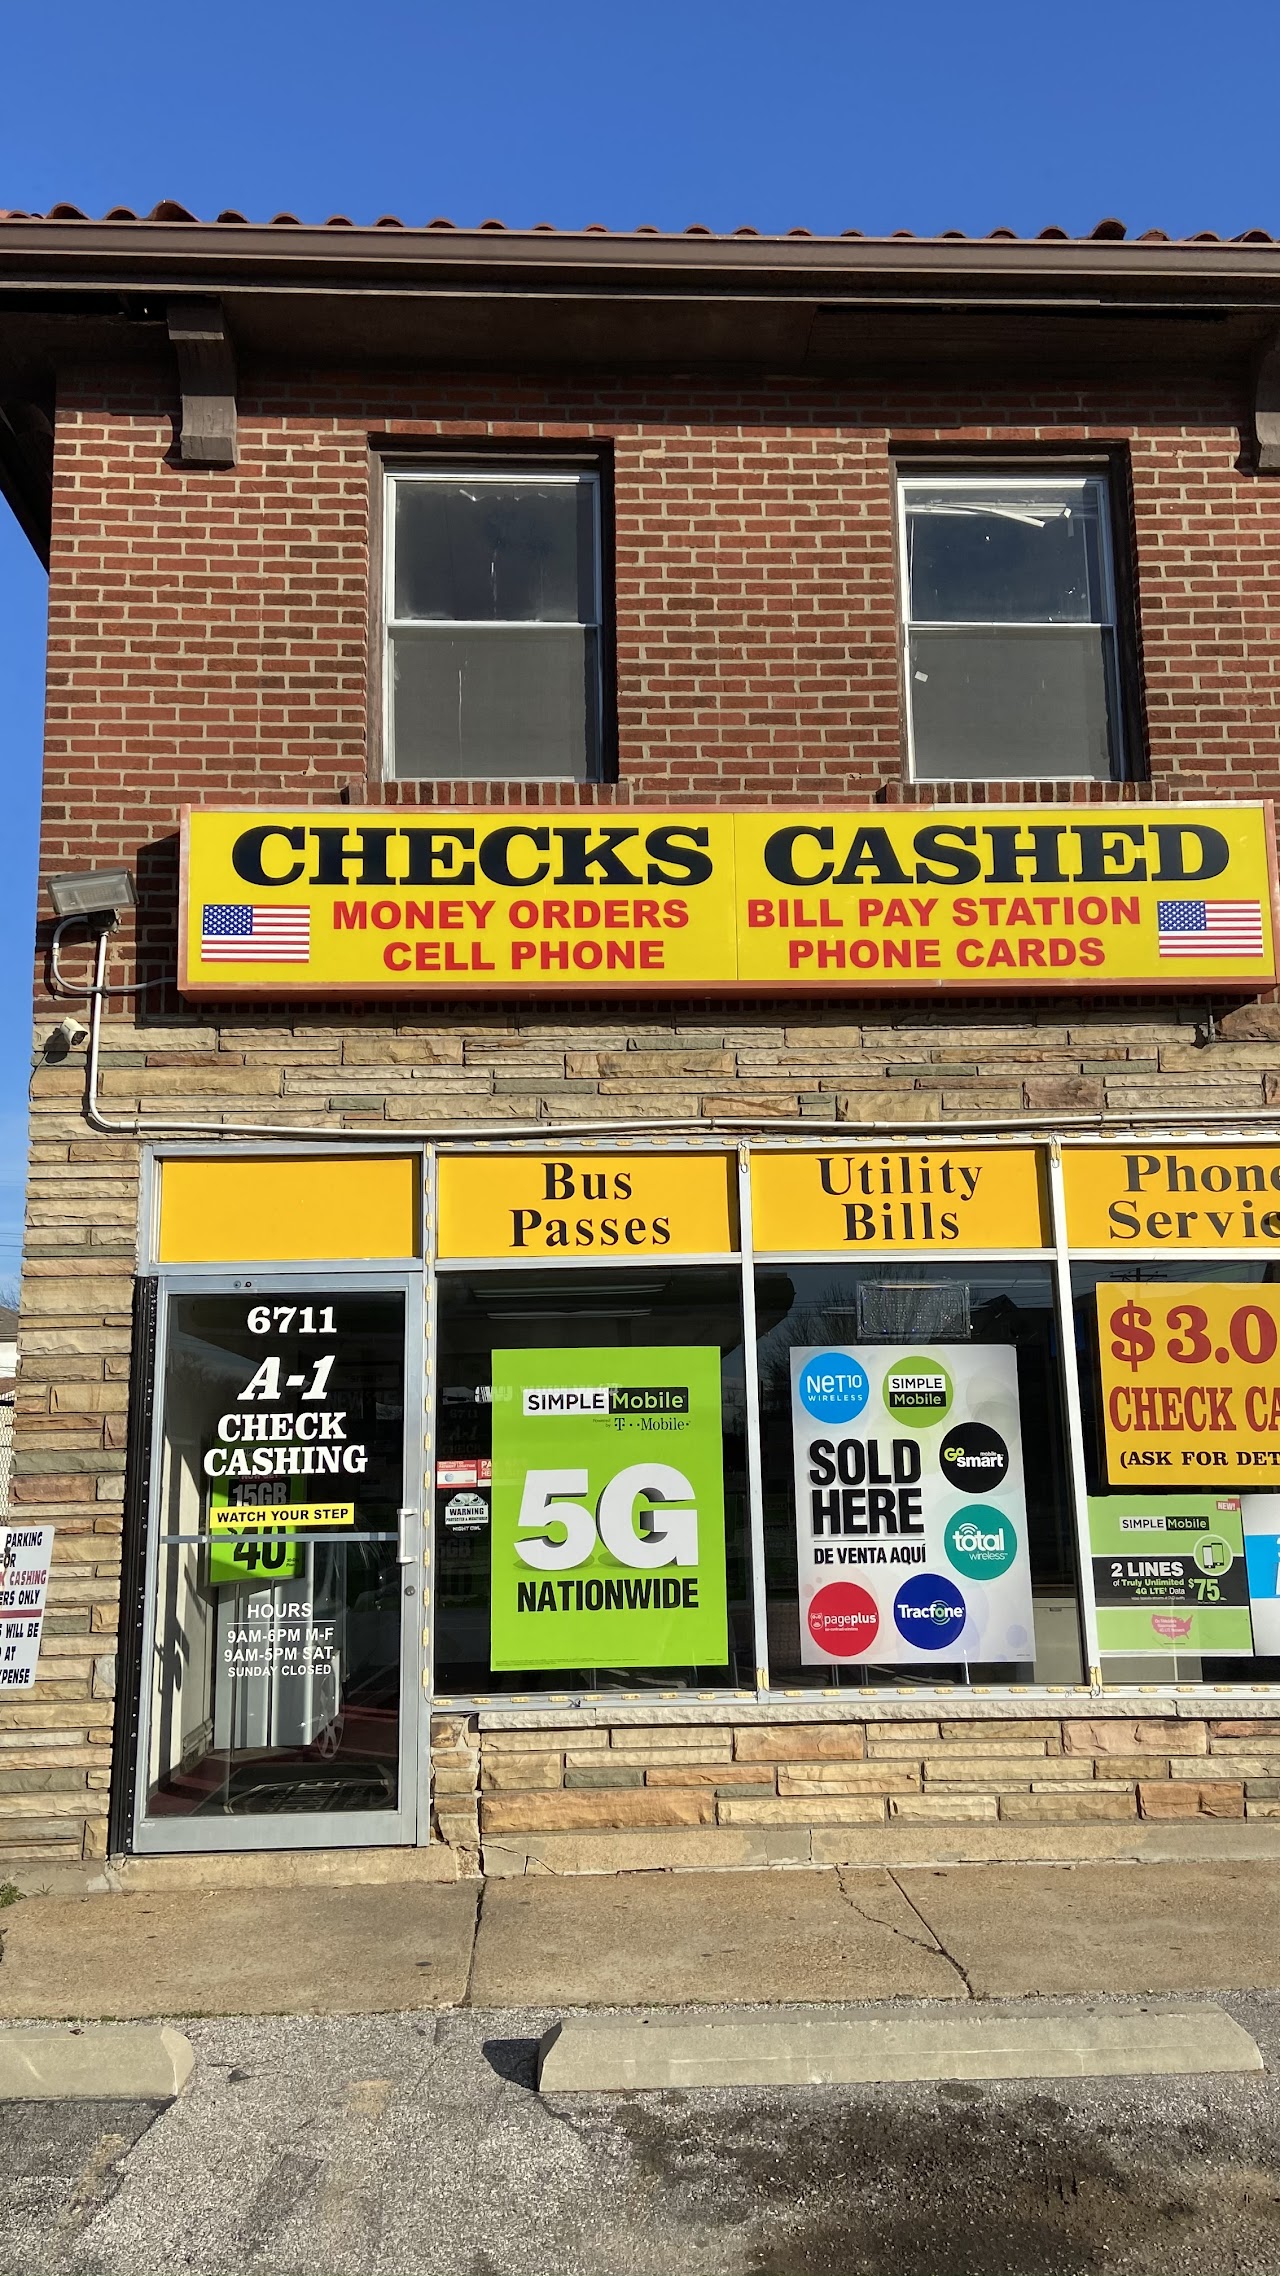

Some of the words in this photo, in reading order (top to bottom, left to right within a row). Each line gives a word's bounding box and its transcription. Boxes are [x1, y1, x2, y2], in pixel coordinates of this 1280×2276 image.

[231, 824, 714, 887] CHECKS
[763, 823, 1230, 886] CASHED
[333, 899, 496, 930] MONEY
[509, 899, 690, 929] ORDERS
[747, 898, 844, 928] BILL
[859, 898, 936, 927] PAY
[952, 896, 1141, 927] STATION
[383, 941, 495, 971] CELL
[511, 940, 665, 970] PHONE
[789, 938, 941, 969] PHONE
[956, 937, 1106, 967] CARDS
[541, 1162, 633, 1201] Bus
[816, 1155, 984, 1202] Utility
[508, 1208, 672, 1248] Passes
[842, 1202, 961, 1242] Bills
[246, 1305, 338, 1335] 6711
[236, 1354, 336, 1401] A-1
[892, 1378, 943, 1389] SIMPLE
[528, 1392, 606, 1411] SIMPLE
[612, 1391, 685, 1410] Mobile
[808, 1394, 863, 1402] WIRELESS
[894, 1393, 942, 1406] Mobile
[1109, 1385, 1237, 1433] CHECK
[217, 1411, 347, 1443] CHECK
[203, 1444, 368, 1478] CASHING
[808, 1438, 923, 1487] SOLD
[1120, 1450, 1173, 1469] (ASK
[1181, 1450, 1229, 1467] FOR
[449, 1507, 484, 1516] WARNING
[811, 1487, 925, 1536] HERE
[1217, 1501, 1236, 1511] NEW!
[217, 1511, 266, 1523] WATCH
[271, 1510, 309, 1522] YOUR
[314, 1508, 349, 1520] STEP
[513, 1462, 699, 1571] 5G
[1122, 1518, 1164, 1529] SIMPLE
[1167, 1517, 1207, 1529] Mobile
[5, 1531, 43, 1548] PARKING
[952, 1527, 1005, 1553] total
[814, 1547, 834, 1565] DE
[838, 1546, 887, 1564] VENTA
[890, 1543, 927, 1565] AQUÍ
[969, 1552, 1006, 1561] wireless
[9, 1569, 47, 1586] CASHING
[1110, 1562, 1124, 1578] 2
[1127, 1561, 1184, 1577] LINES
[1112, 1579, 1120, 1587] of
[1120, 1578, 1143, 1588] Truly
[1144, 1578, 1185, 1587] Unlimited
[1135, 1587, 1148, 1595] 4G
[1168, 1587, 1186, 1595] Data
[18, 1589, 40, 1605] ONLY
[516, 1577, 700, 1613] NATIONWIDE
[247, 1602, 312, 1619] HOURS
[824, 1611, 877, 1627] pageplus
[897, 1604, 963, 1620] Tracfone
[5, 1623, 24, 1638] WILL
[27, 1622, 39, 1637] BE
[227, 1628, 301, 1643] 9AM-6PM
[305, 1627, 335, 1641] M-F
[4, 1646, 16, 1661] AT
[223, 1646, 298, 1662] 9AM-5PM
[227, 1665, 279, 1678] SUNDAY
[281, 1664, 332, 1676] CLOSED
